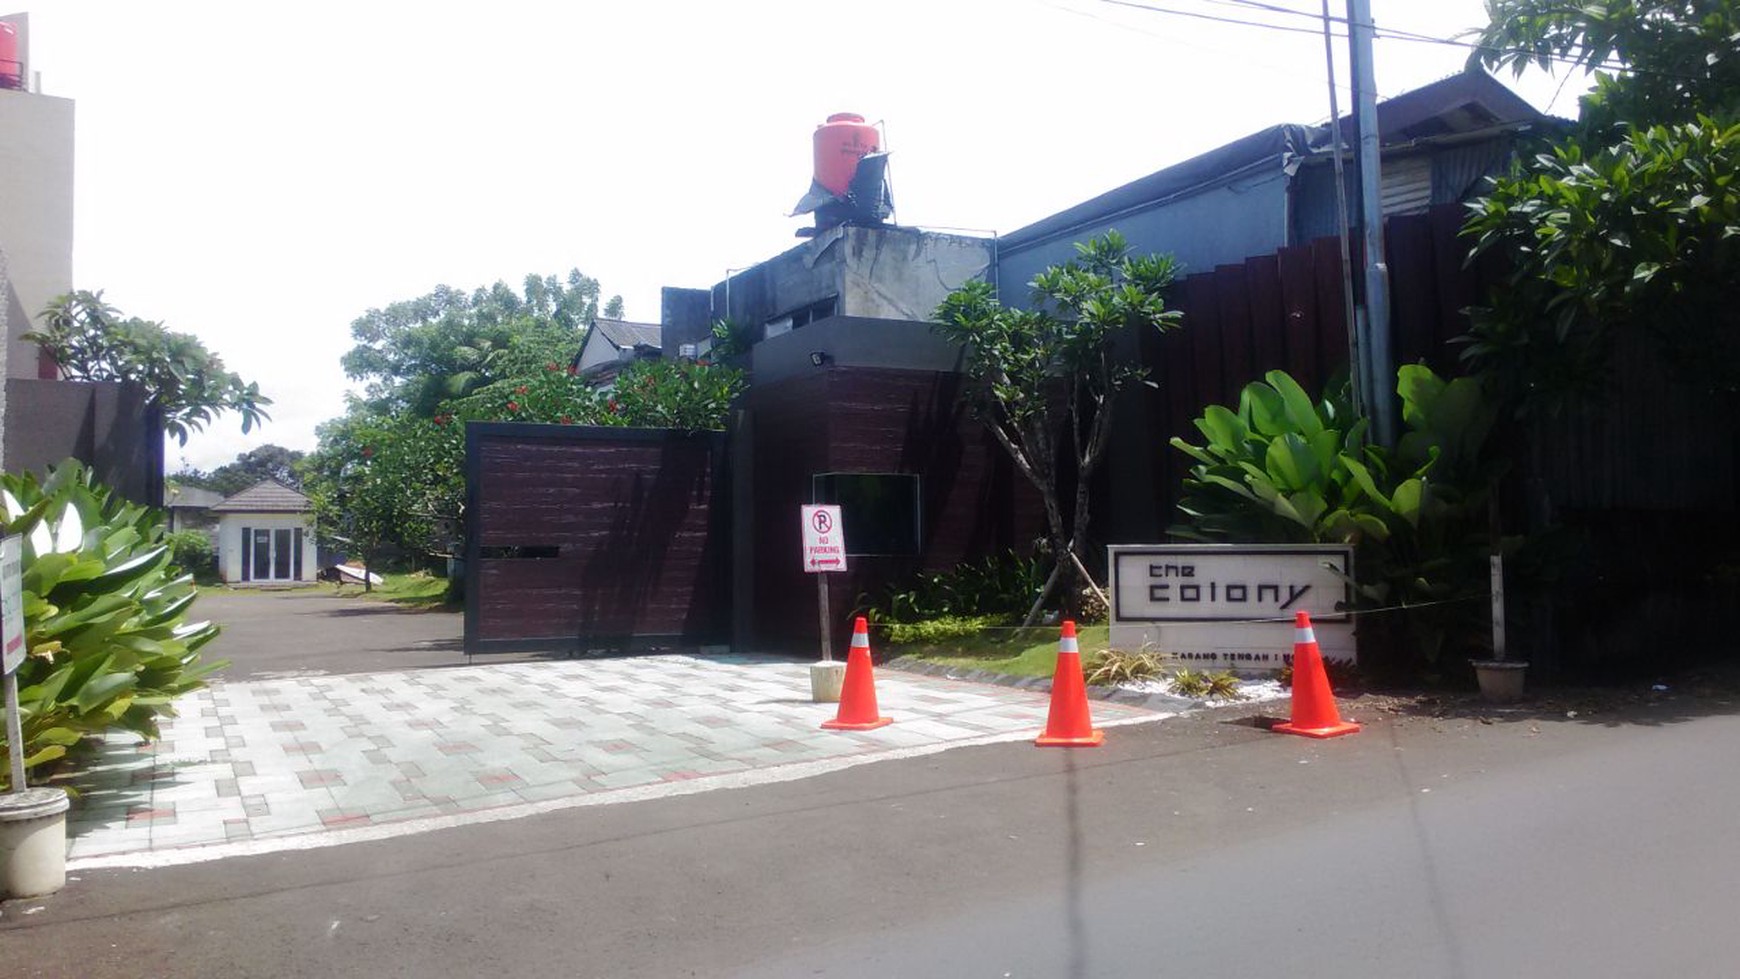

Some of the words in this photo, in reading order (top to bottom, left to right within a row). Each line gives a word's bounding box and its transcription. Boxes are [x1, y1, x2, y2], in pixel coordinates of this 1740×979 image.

[819, 537, 829, 545] NO
[810, 546, 840, 554] PARKING
[1149, 564, 1195, 578] the
[1149, 581, 1312, 610] colony
[1222, 653, 1269, 661] TENGAH
